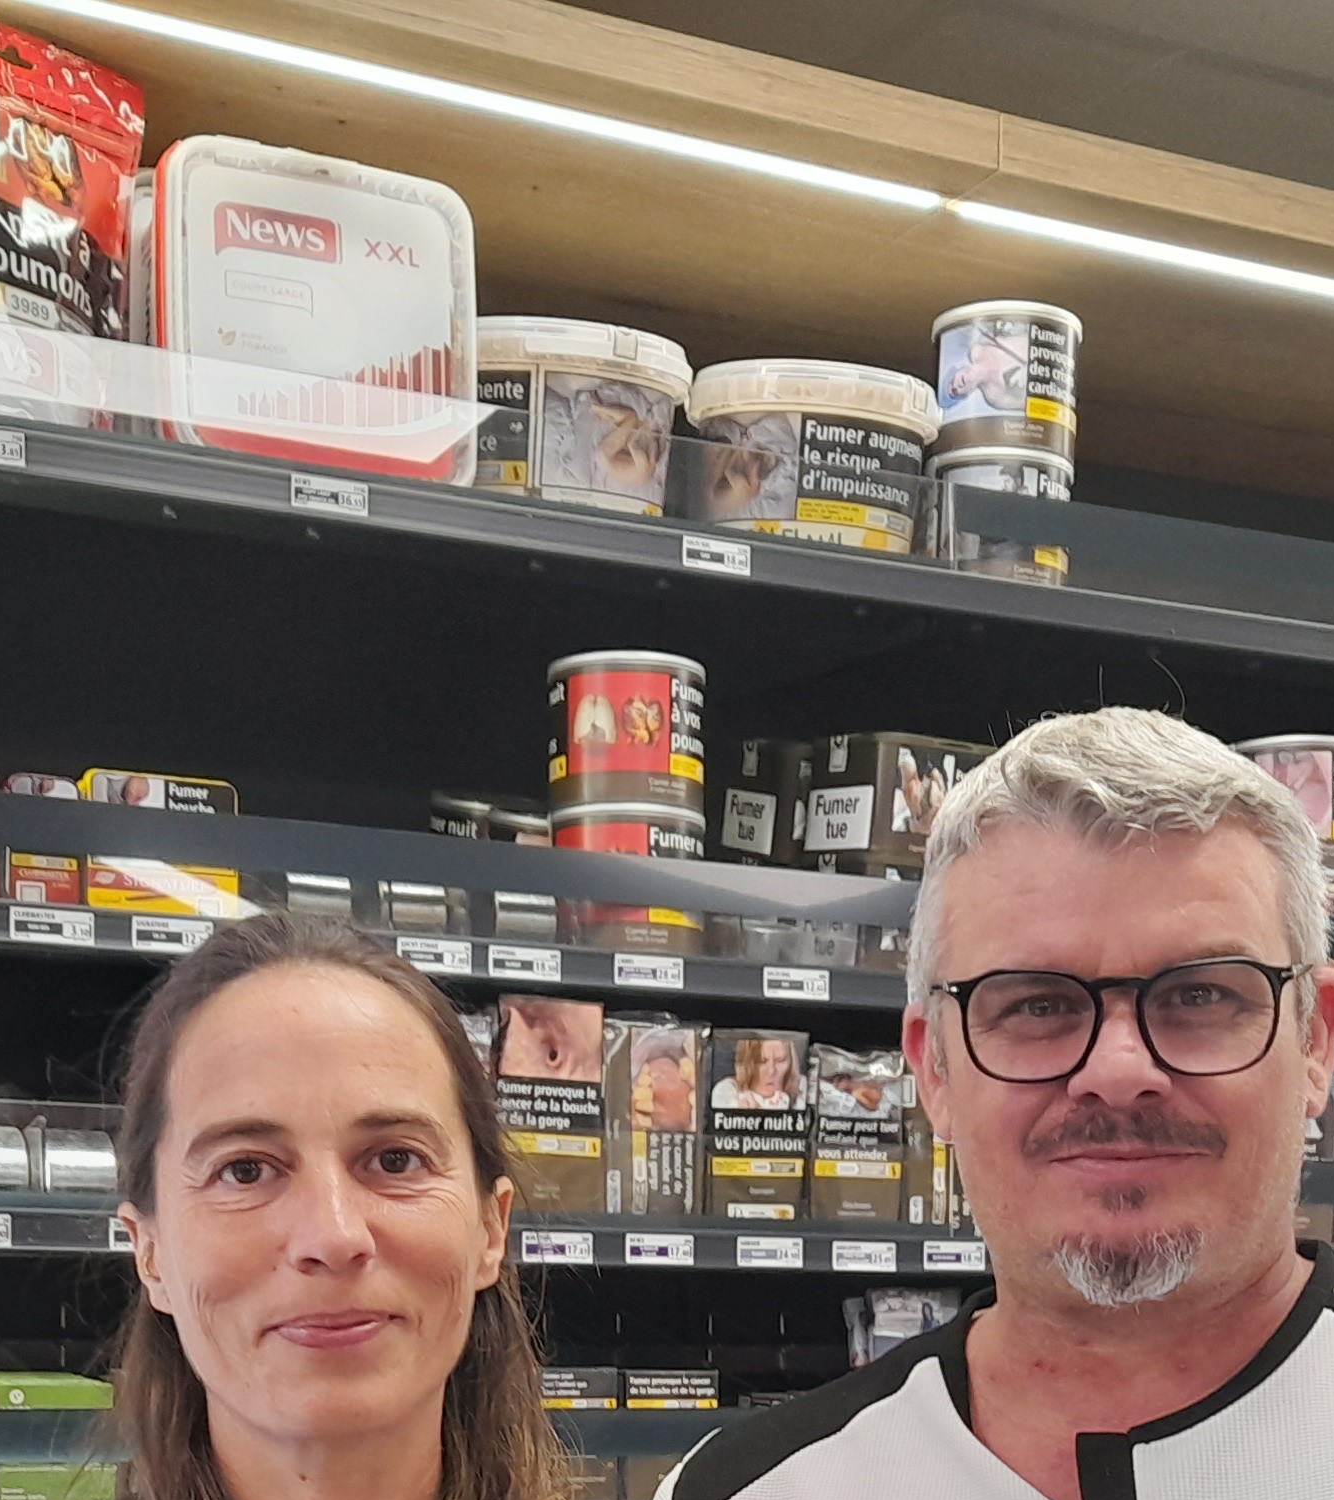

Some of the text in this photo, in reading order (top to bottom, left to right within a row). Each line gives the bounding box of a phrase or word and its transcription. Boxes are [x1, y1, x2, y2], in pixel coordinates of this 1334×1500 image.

[225, 208, 326, 252] News
[364, 238, 420, 268] XXL
[9, 294, 50, 321] 3989
[1030, 324, 1066, 347] Fumer
[1028, 362, 1051, 379] des
[804, 418, 866, 446] Fumer
[803, 444, 881, 475] le risque
[801, 469, 910, 507] d'impuissance
[671, 703, 702, 731] à vos
[168, 782, 210, 801] Fumer
[729, 793, 765, 820] Fumer
[814, 794, 861, 817] Fumer
[448, 818, 479, 840] nuit
[738, 820, 755, 842] tue
[825, 820, 848, 840] tue
[649, 826, 696, 855] Fumer
[122, 873, 206, 892] SIGNATURE
[496, 1080, 597, 1100] Fumer provoque le
[496, 1098, 600, 1116] cancer de la bouche
[509, 1111, 571, 1131] de la gorge
[714, 1112, 805, 1132] Fumer nuit à
[819, 1117, 852, 1133] Fumer
[853, 1119, 878, 1135] peut
[714, 1136, 740, 1151] vos
[818, 1148, 888, 1162] vous attendez
